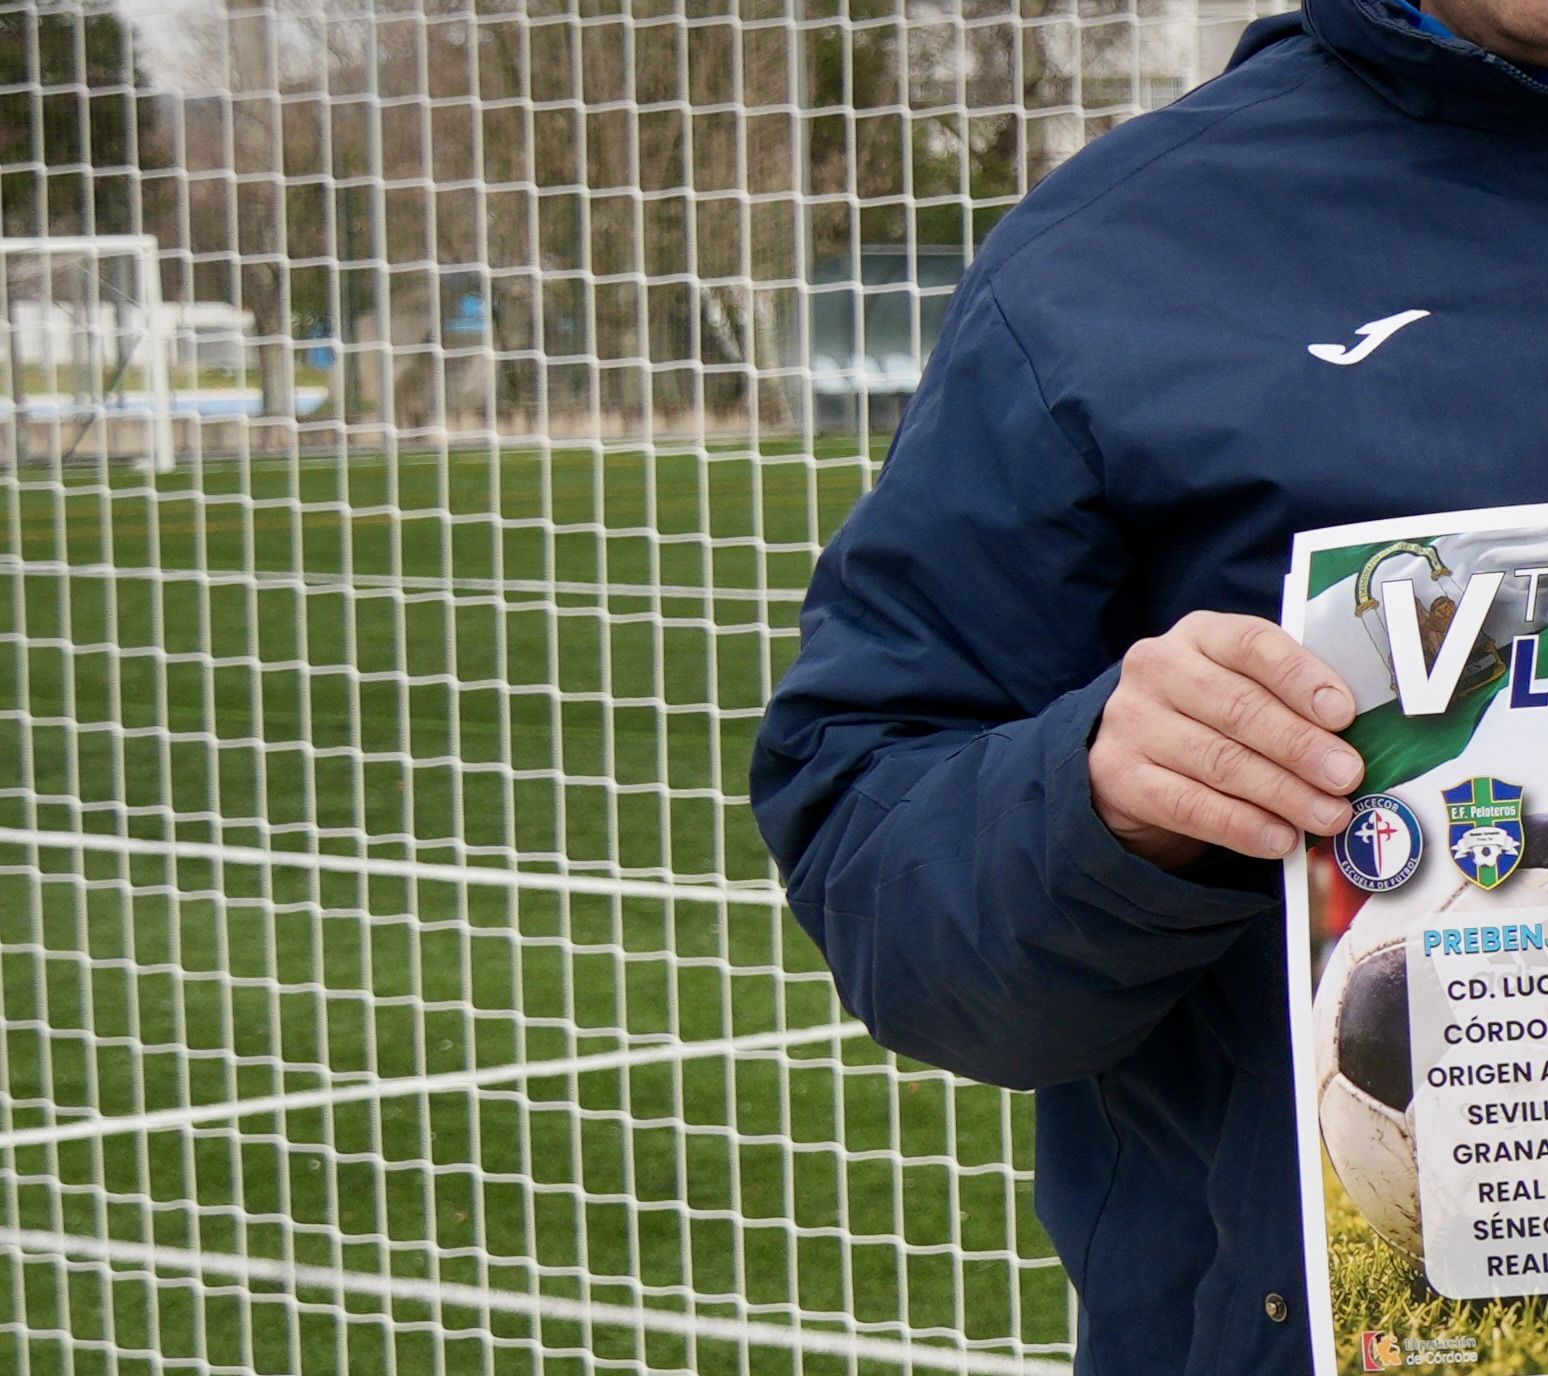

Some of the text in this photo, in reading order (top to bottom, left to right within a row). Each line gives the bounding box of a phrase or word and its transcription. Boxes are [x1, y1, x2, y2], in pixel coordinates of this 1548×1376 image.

[1382, 572, 1504, 716] V
[1451, 805, 1516, 819] E.F. Peloteros
[1448, 979, 1496, 1000] CD.
[1428, 1061, 1533, 1087] ORIGEN
[1479, 1179, 1546, 1203] REAL
[1421, 1348, 1478, 1364] Córdoba
